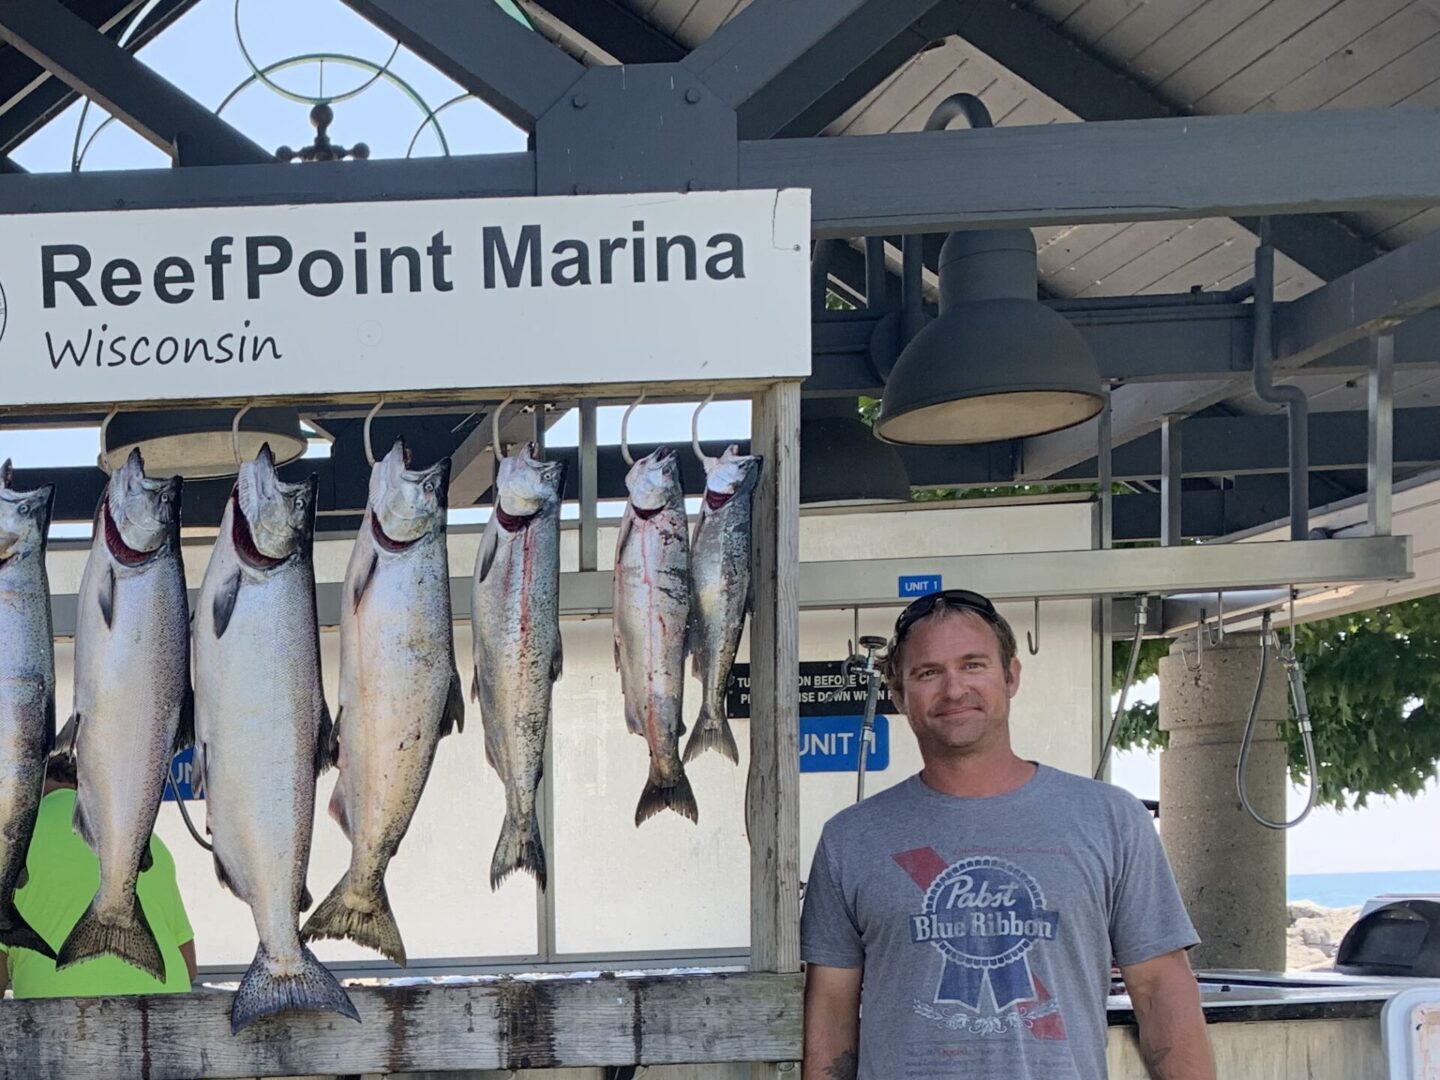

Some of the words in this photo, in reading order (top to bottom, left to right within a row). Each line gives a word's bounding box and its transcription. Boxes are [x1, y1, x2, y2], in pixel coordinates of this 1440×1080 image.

[40, 230, 454, 309] ReefPoint
[482, 219, 747, 290] Marina
[44, 319, 283, 370] Wisconsin
[904, 581, 929, 592] UNIT
[933, 580, 938, 590] 1
[853, 690, 885, 702] WHN
[944, 874, 1019, 910] Pabst
[912, 913, 966, 942] Blue
[970, 911, 1053, 939] Ribbon
